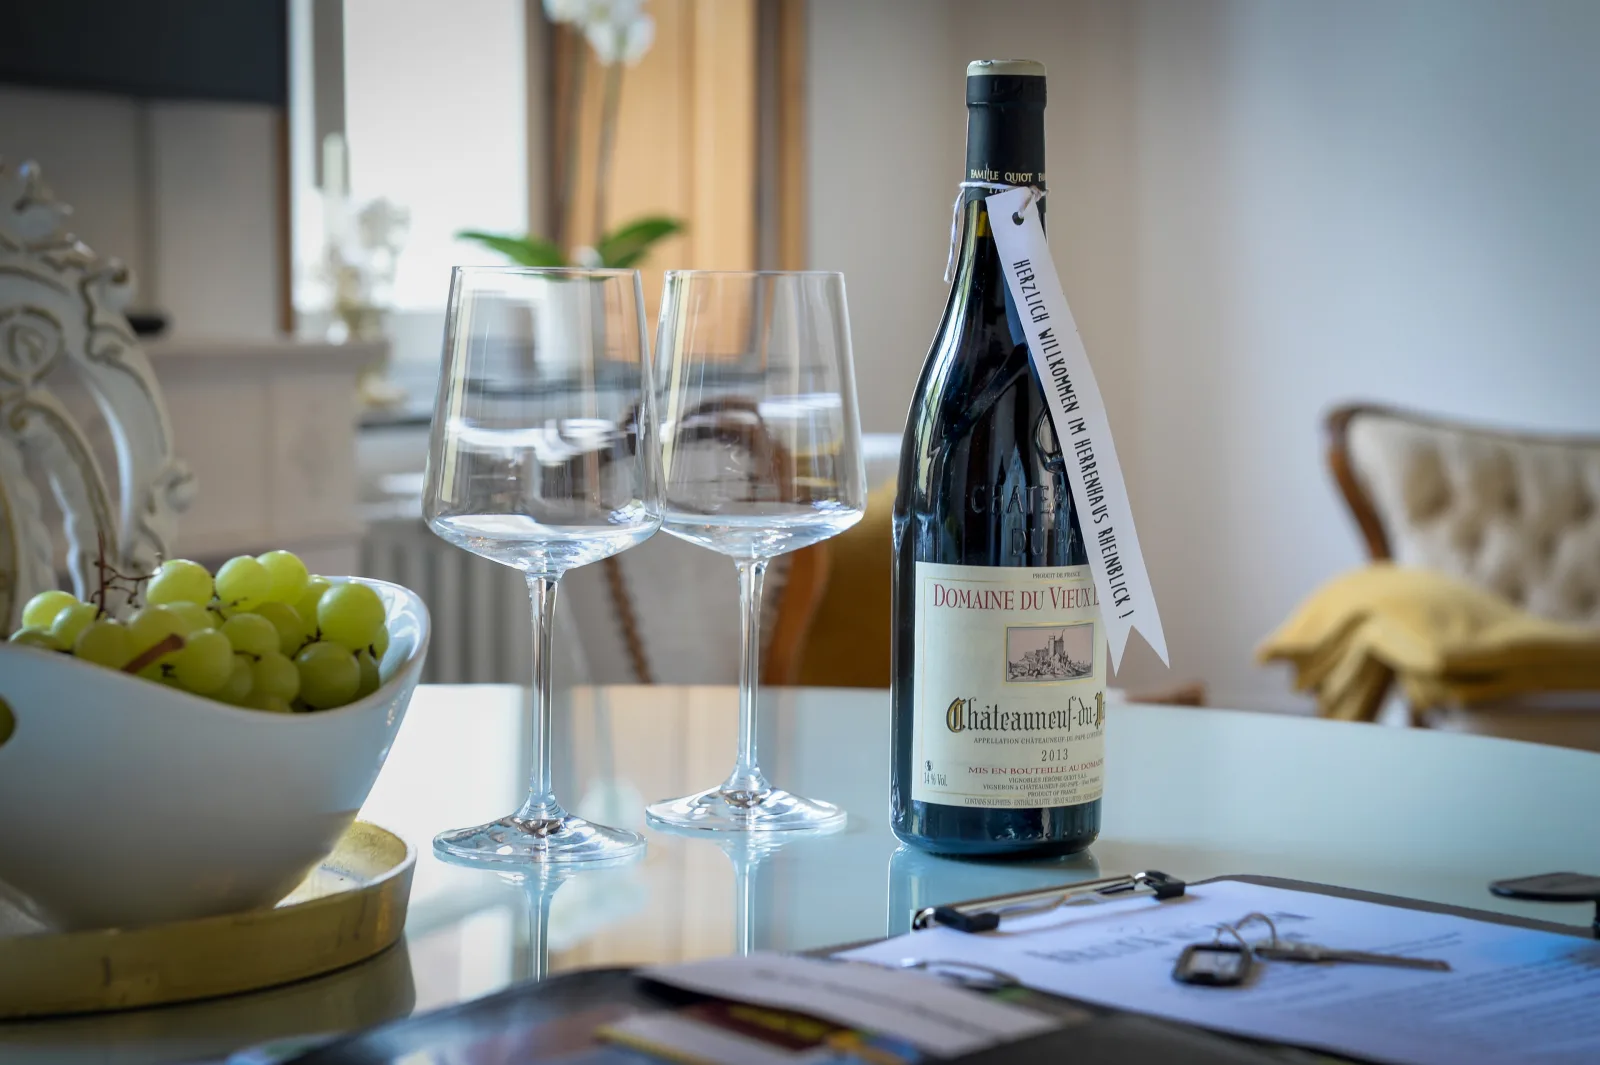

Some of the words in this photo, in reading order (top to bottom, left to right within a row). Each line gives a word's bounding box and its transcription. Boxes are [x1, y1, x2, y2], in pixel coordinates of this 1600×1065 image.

[970, 163, 999, 182] FAMILLE
[1004, 171, 1033, 184] QUIOT
[1012, 258, 1050, 324] HERZLICH
[1037, 327, 1081, 414] WILLKOMMEN
[1067, 416, 1087, 436] IM
[1073, 437, 1109, 525] HERRENHAUS
[1097, 526, 1131, 608] RHEINBLICK
[933, 583, 1015, 611] DOMAINE
[1019, 589, 1045, 611] DU
[1048, 585, 1091, 610] VIEUX
[973, 736, 1019, 745] APPELLATION
[1041, 748, 1069, 762] 2013
[968, 766, 988, 775] MIS
[991, 767, 1007, 775] EN
[1010, 765, 1067, 775] BOUTEILLE
[1068, 763, 1080, 772] AU
[983, 783, 1014, 791] VIGNERON
[1008, 775, 1041, 784] VIGNOBLES
[1027, 788, 1052, 798] PRODUCT
